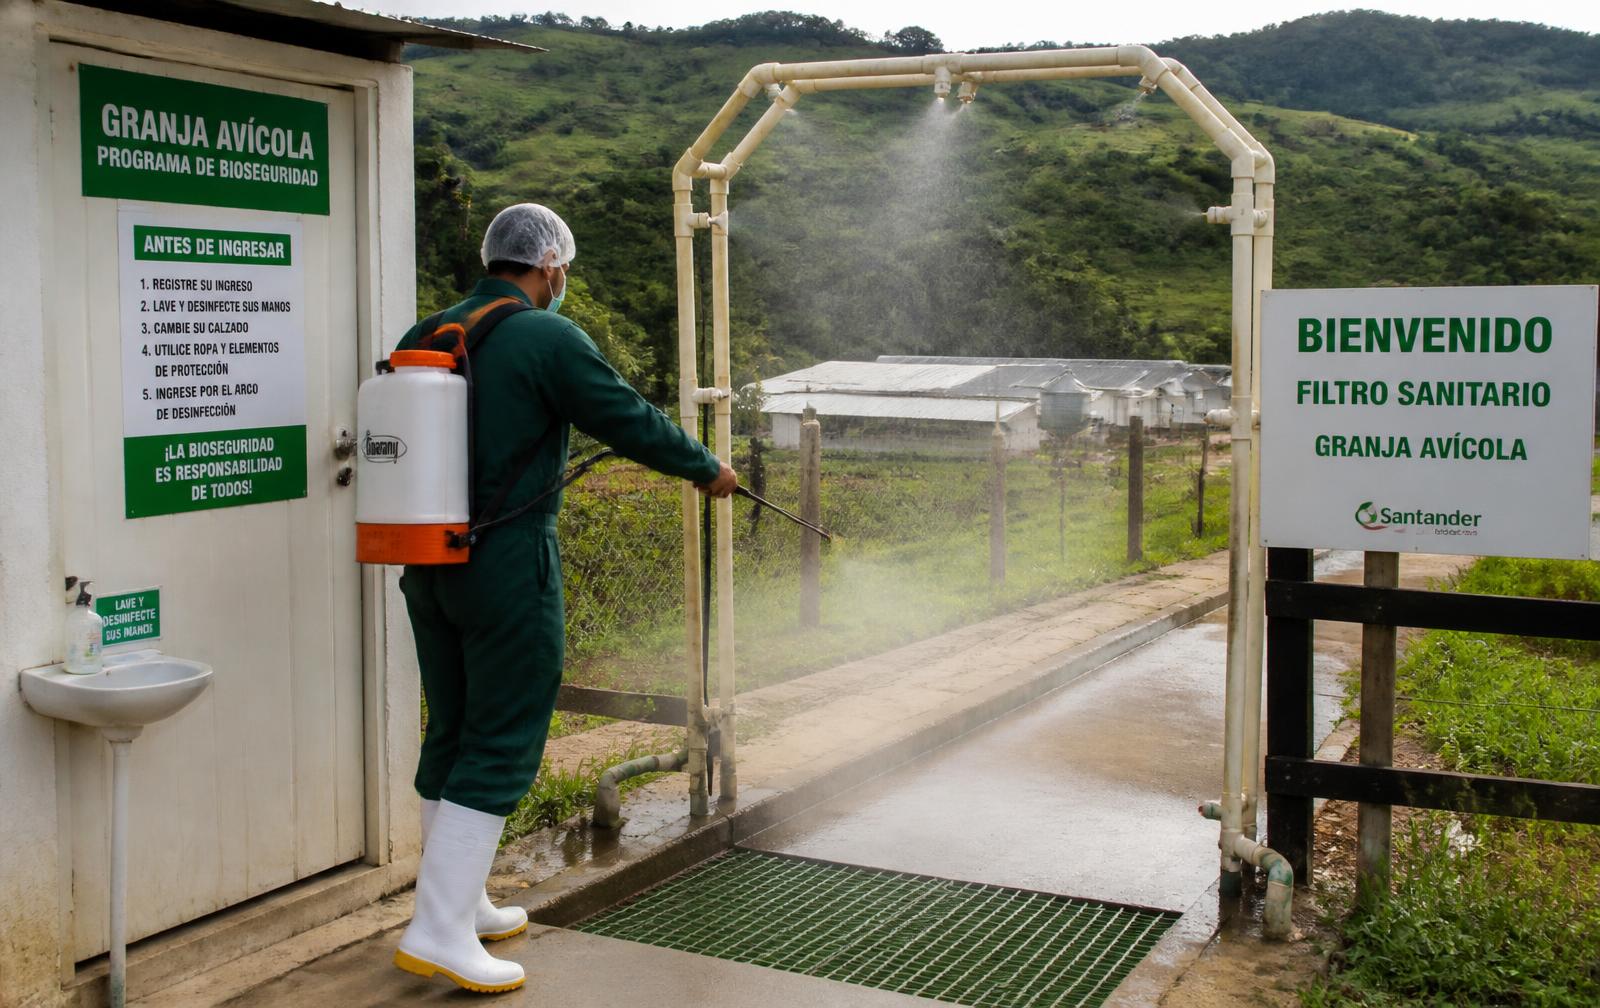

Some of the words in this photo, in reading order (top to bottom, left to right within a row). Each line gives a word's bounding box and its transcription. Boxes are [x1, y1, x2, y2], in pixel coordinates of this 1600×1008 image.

[102, 103, 208, 148] GRANJA
[216, 117, 314, 160] AVÍCOLA
[98, 145, 191, 174] PROGRAMA
[196, 159, 215, 177] DE
[220, 160, 318, 187] BIOSEGURIDAD
[144, 235, 191, 254] ANTES
[196, 238, 214, 255] DE
[219, 240, 284, 259] INGRESAR
[140, 278, 149, 290] 1.
[153, 279, 197, 291] REGISTRE
[201, 280, 212, 291] SU
[215, 280, 252, 291] INGRESO
[141, 300, 150, 312] 2.
[153, 300, 176, 312] LAVE
[179, 301, 185, 312] Y
[188, 301, 240, 312] DESINFECTE
[243, 301, 259, 312] SUS
[261, 302, 291, 313] MANOS
[141, 323, 150, 334] 3.
[154, 322, 190, 334] CAMBIE
[193, 322, 205, 334] SU
[208, 322, 248, 333] CALZADO
[1298, 317, 1552, 353] BIENVENIDO
[142, 345, 151, 356] 4.
[155, 344, 191, 356] UTILICE
[194, 344, 218, 355] ROPA
[221, 343, 226, 354] Y
[229, 342, 279, 354] ELEMENTOS
[155, 365, 168, 377] DE
[171, 361, 228, 376] PROTECCIÓN
[143, 388, 152, 400] 5.
[156, 387, 196, 400] INGRESE
[200, 386, 219, 397] POR
[221, 385, 232, 396] EL
[235, 384, 258, 395] ARCO
[1297, 380, 1388, 405] FILTRO
[1398, 381, 1550, 407] SANITARIO
[157, 408, 168, 420] DE
[172, 404, 236, 419] DESINFECCIÓN
[165, 444, 185, 462] ¡LA
[189, 438, 274, 457] BIOSEGURIDAD
[1315, 435, 1412, 458] GRANJA
[1420, 432, 1527, 460] AVÍCOLA
[155, 467, 171, 483] ES
[176, 457, 282, 481] RESPONSABILIDAD
[191, 485, 207, 500] DE
[210, 480, 252, 498] TODOS!
[1380, 508, 1482, 526] Santander
[115, 598, 136, 610] LAVE
[139, 596, 144, 607] Y
